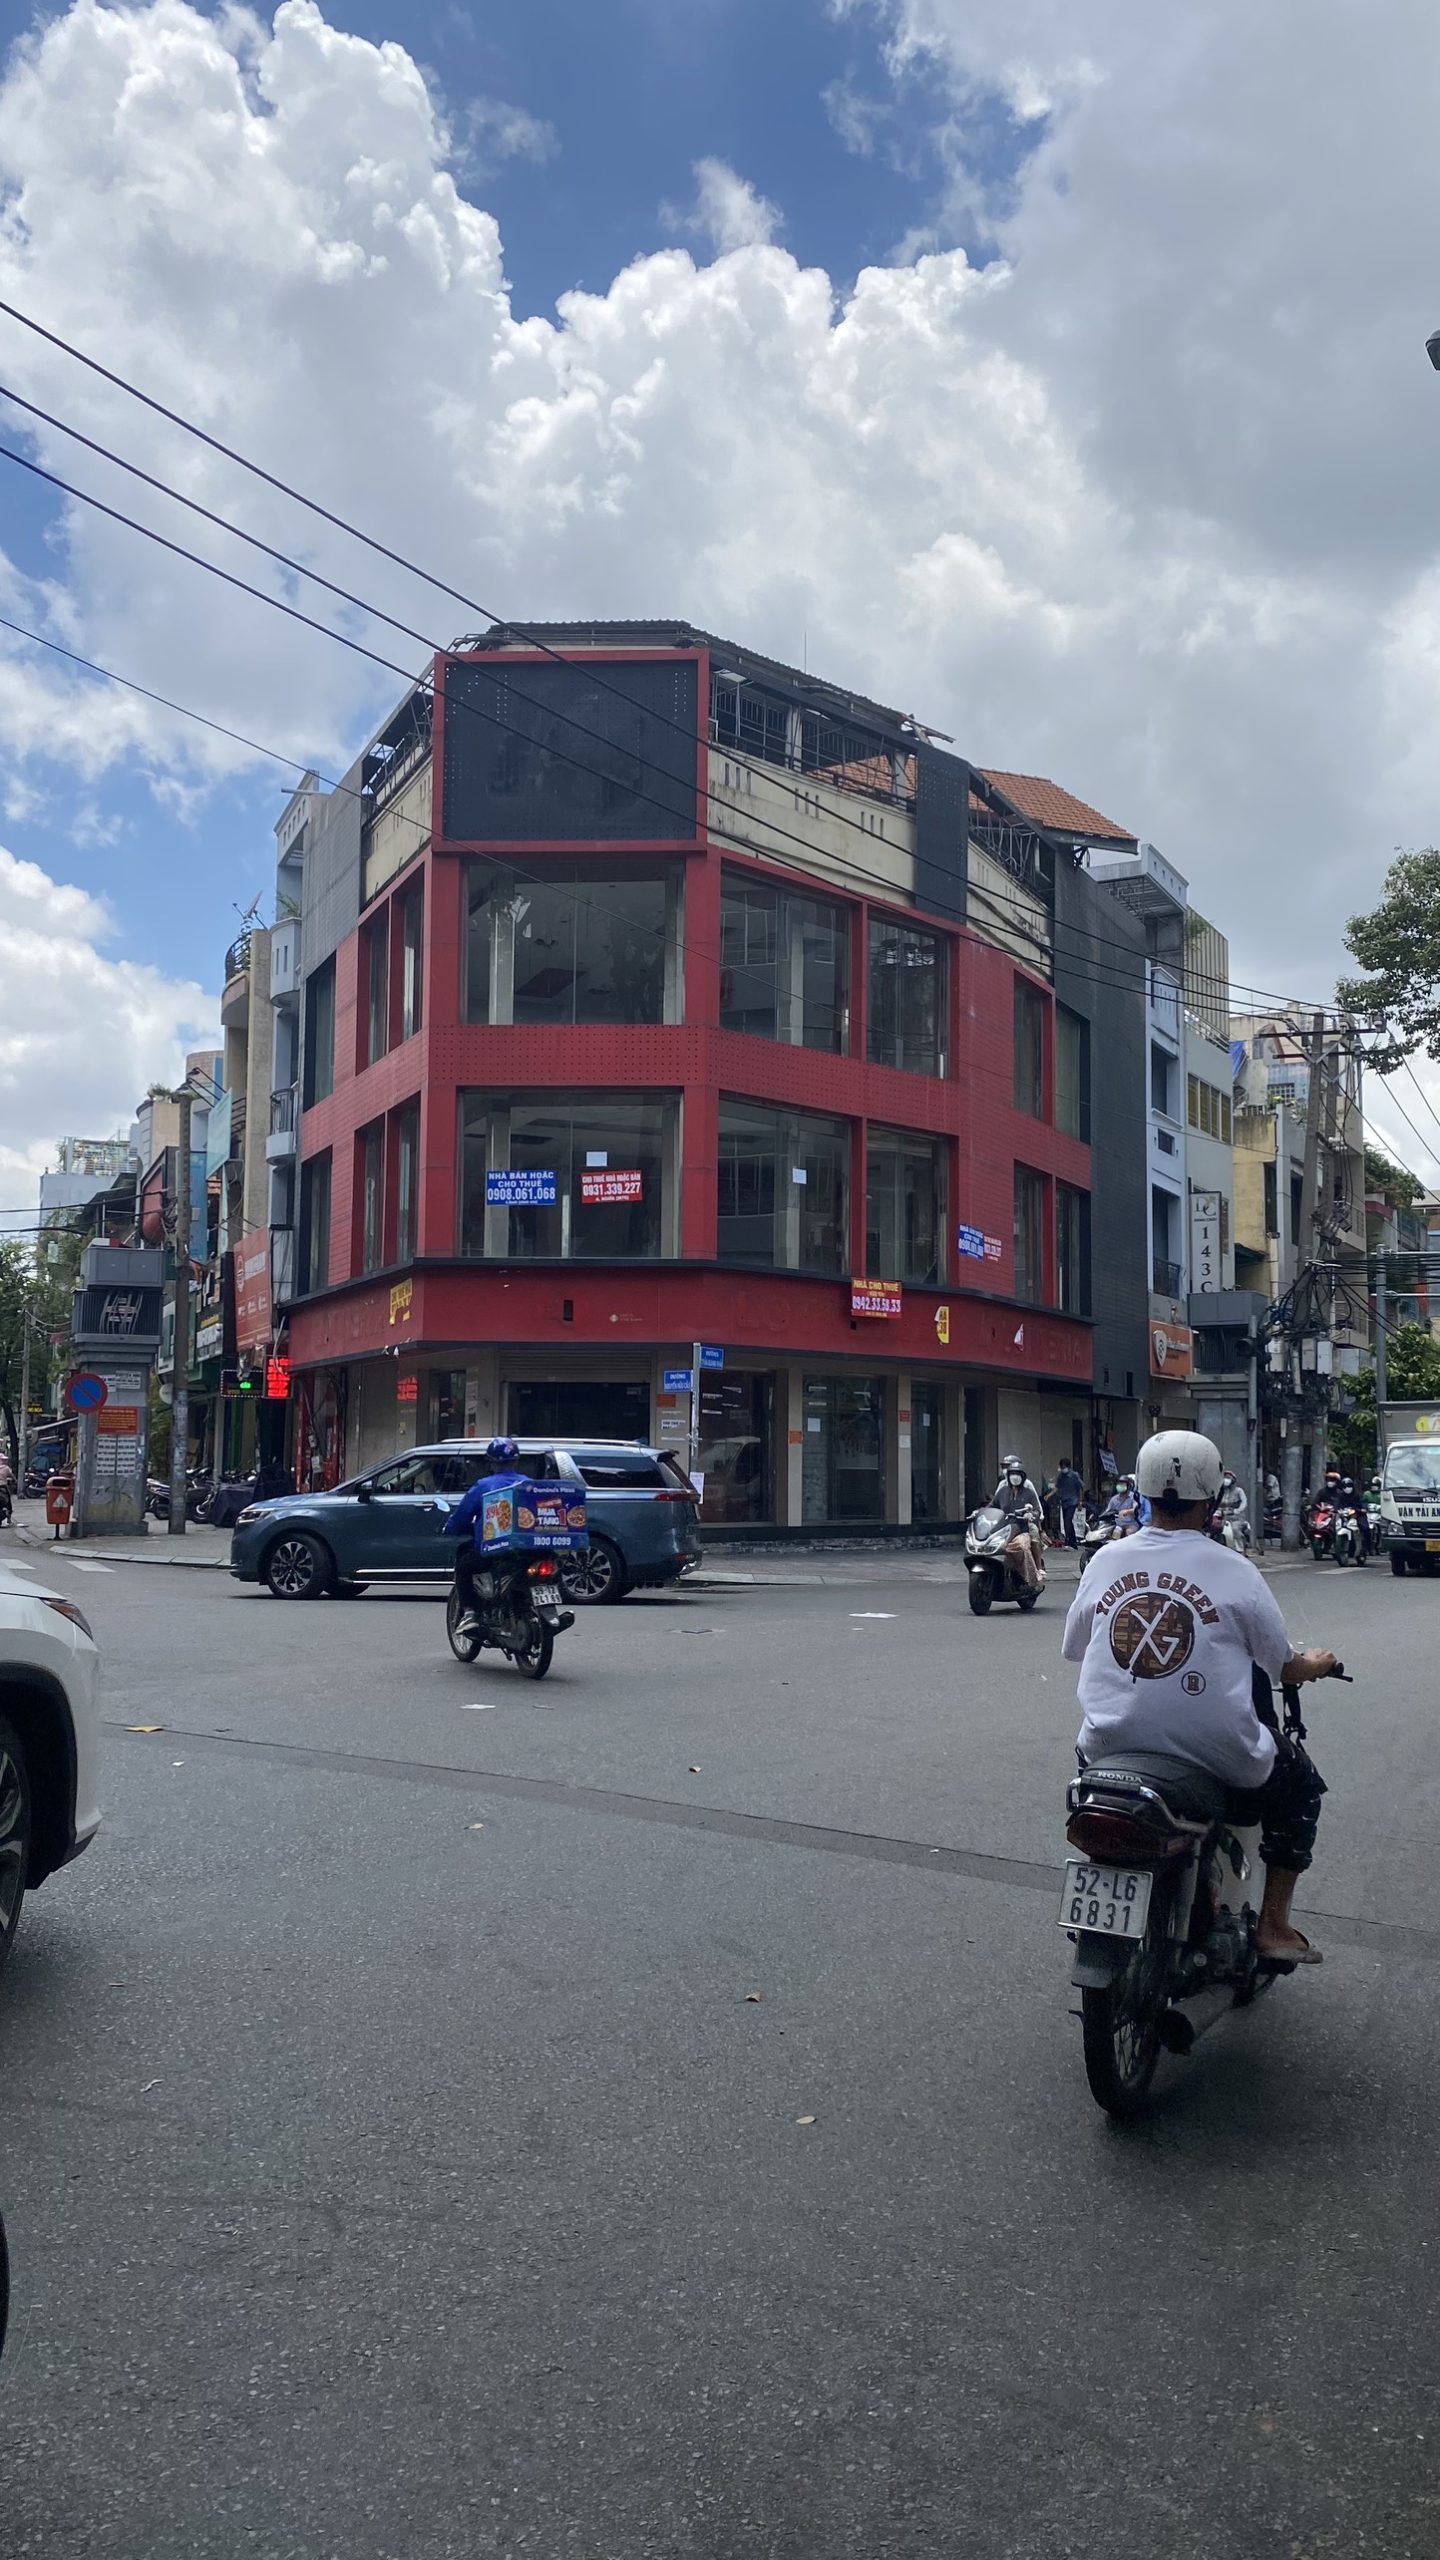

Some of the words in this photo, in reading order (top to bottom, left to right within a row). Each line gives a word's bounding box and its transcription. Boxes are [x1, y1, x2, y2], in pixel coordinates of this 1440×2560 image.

[488, 1171, 507, 1180] NHÀ
[509, 1170, 527, 1179] BÁN
[498, 1180, 517, 1188] CHO
[519, 1179, 542, 1187] THUÊ
[583, 1182, 641, 1196] 0931.339.227
[487, 1187, 556, 1200] 0908.061.068
[1096, 1571, 1150, 1616] YOUNG
[1156, 1572, 1220, 1625] GREEN
[1097, 1771, 1143, 1784] HONDA
[1073, 1866, 1139, 1902] 52-L6
[1069, 1897, 1131, 1932] 6831
